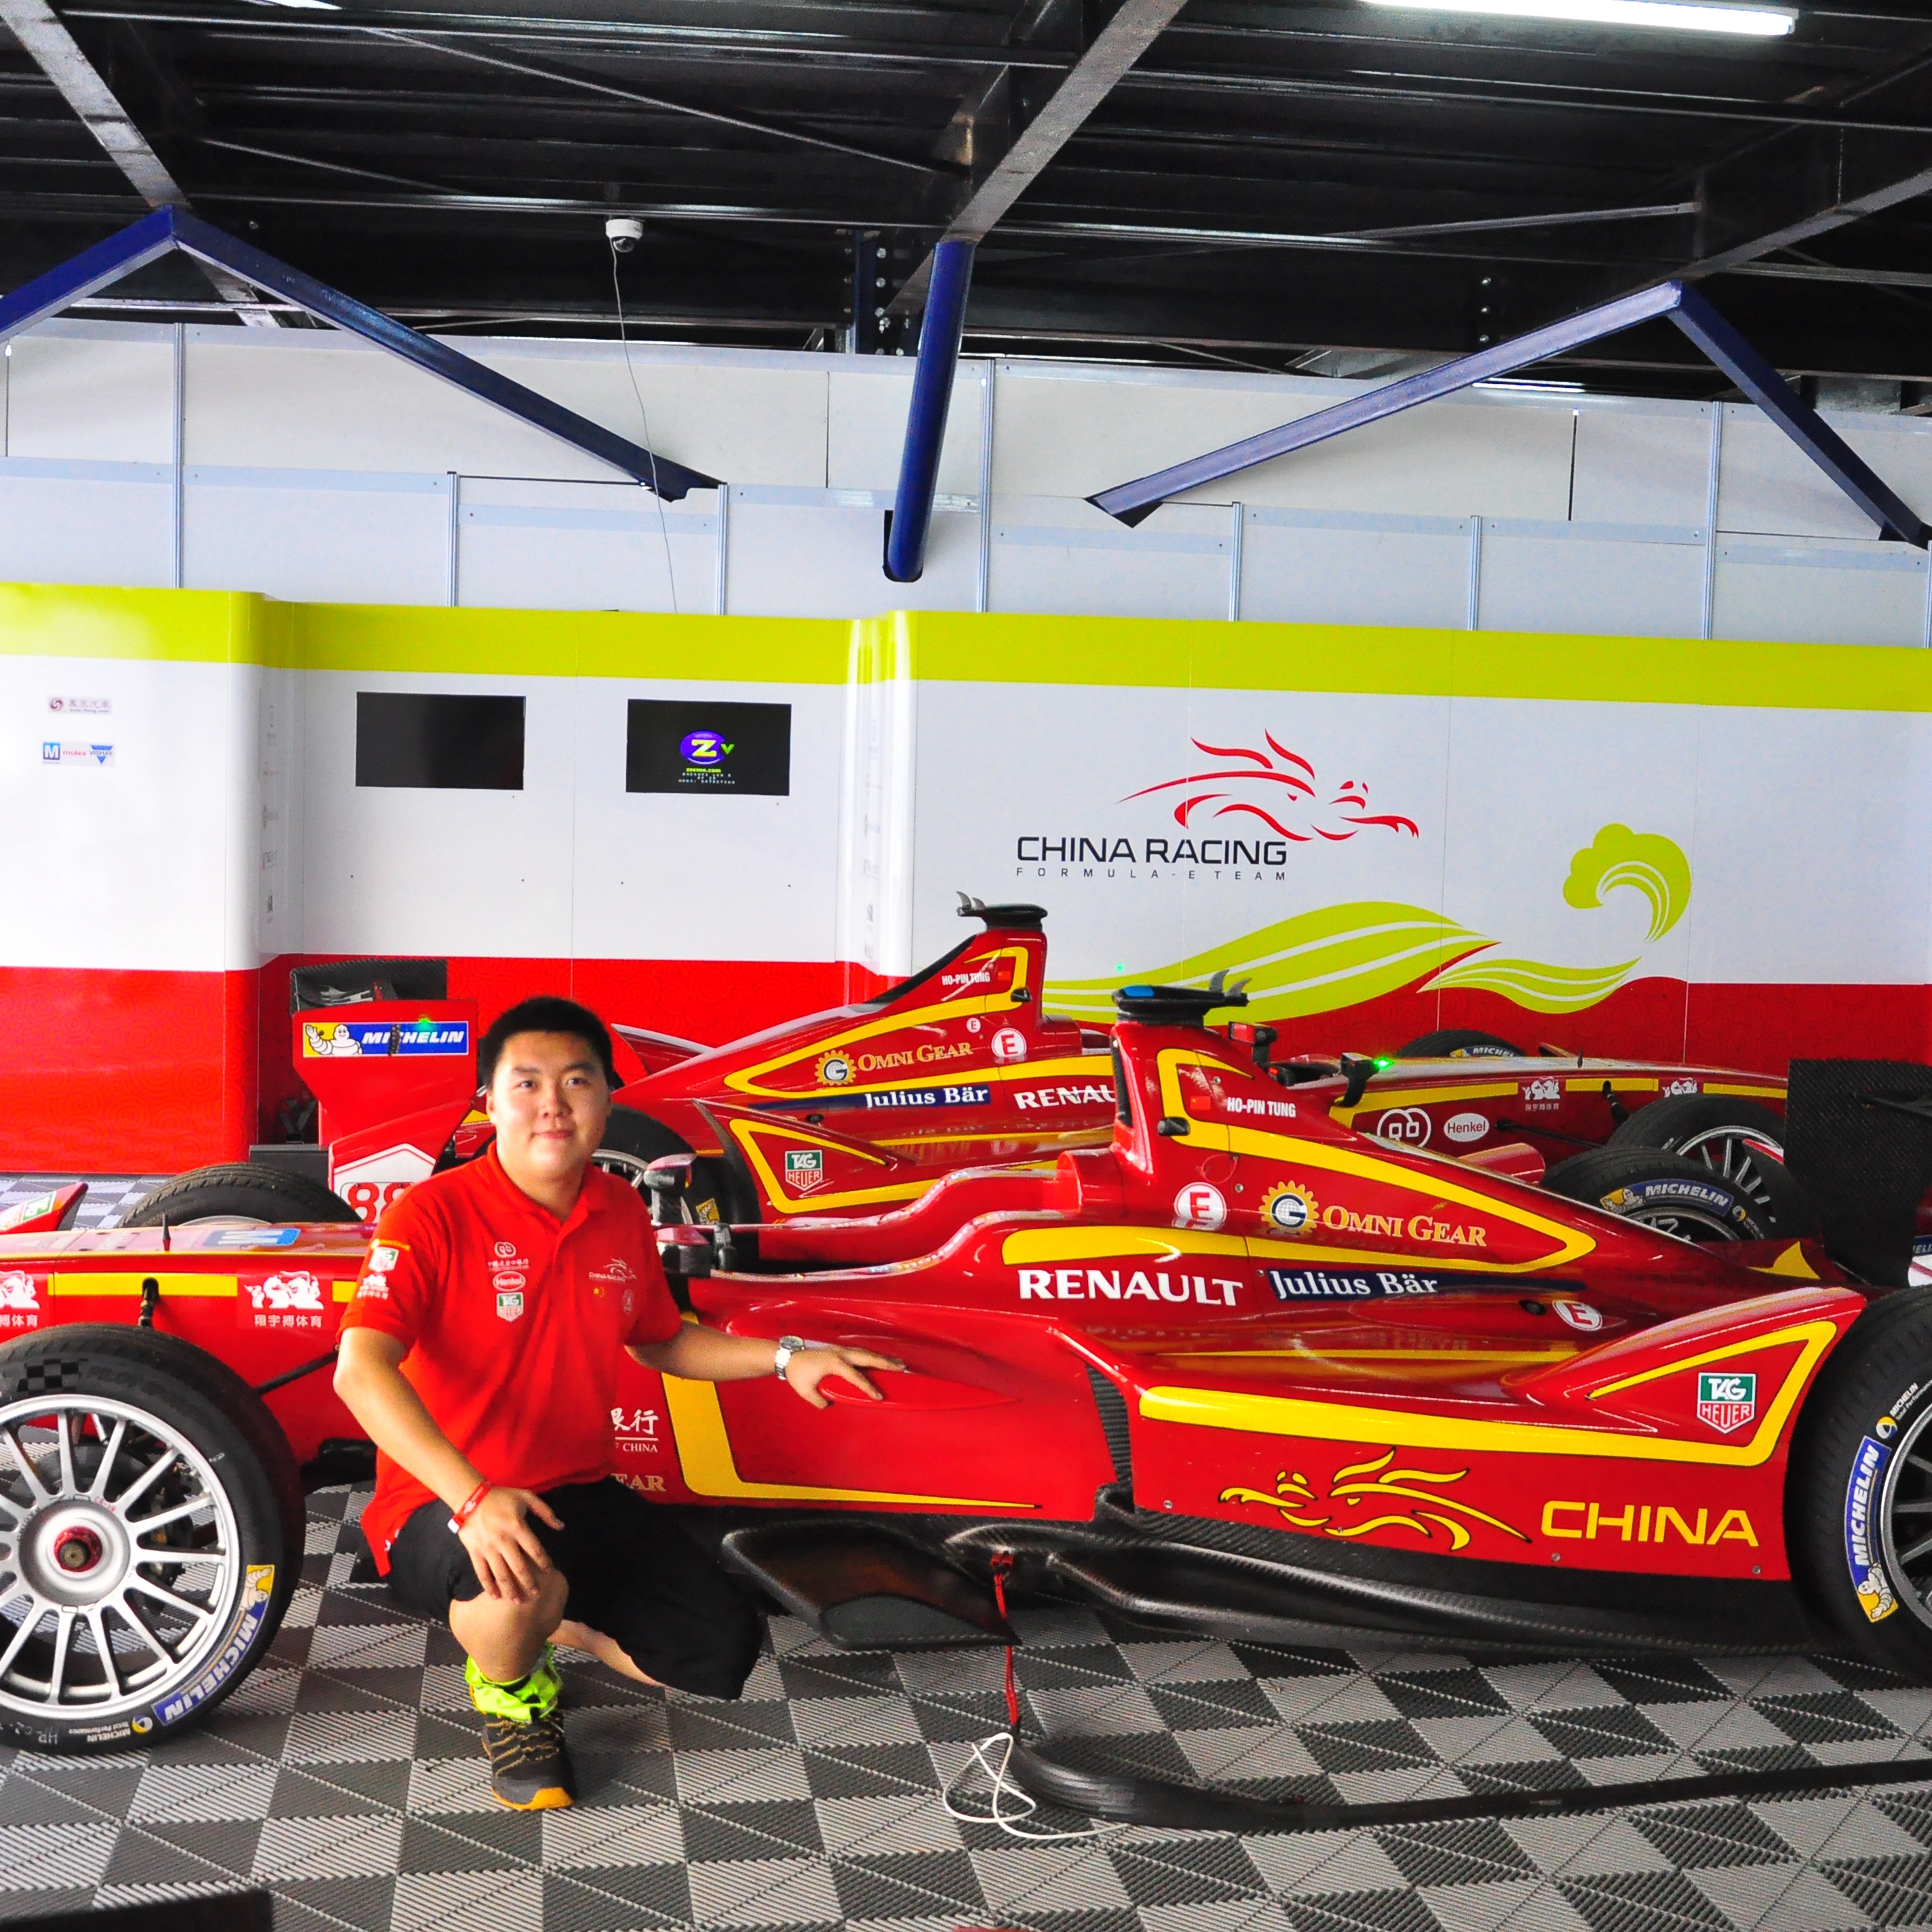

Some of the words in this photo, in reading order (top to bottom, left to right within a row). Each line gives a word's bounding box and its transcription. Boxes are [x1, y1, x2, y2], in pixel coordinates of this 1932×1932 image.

[1018, 836, 1136, 863] CHINA
[1146, 838, 1287, 865] RACING
[942, 974, 969, 986] HO-PIN
[969, 971, 990, 983] TUNG
[362, 1031, 465, 1044] MIHELIN
[858, 1051, 913, 1072] OMNI
[916, 1042, 973, 1062] GEAR
[866, 1090, 935, 1108] Julius
[945, 1087, 989, 1104] Bär
[1226, 1097, 1266, 1115] HO-PIN
[1268, 1100, 1295, 1118] TUNG
[1447, 1119, 1486, 1135] Henkel
[791, 1153, 817, 1168] TAG
[788, 1171, 820, 1187] HEUER
[1190, 1192, 1210, 1216] E
[1645, 1183, 1728, 1206] MICHELIN
[1323, 1205, 1402, 1237] OMNI
[1408, 1216, 1486, 1246] GEAR
[1018, 1269, 1243, 1306] RENAULT
[1270, 1271, 1370, 1299] Julius
[1376, 1273, 1437, 1294] Bär
[1708, 1378, 1746, 1401] TAG
[1890, 1383, 1918, 1417] MICHELIN
[1702, 1406, 1750, 1429] HEUER
[623, 1443, 658, 1452] CHINA
[1849, 1444, 1879, 1566] MICHELIN
[1541, 1501, 1759, 1547] CHINA
[164, 1613, 258, 1722] MICHELIN
[86, 1728, 131, 1742] MICHELIN
